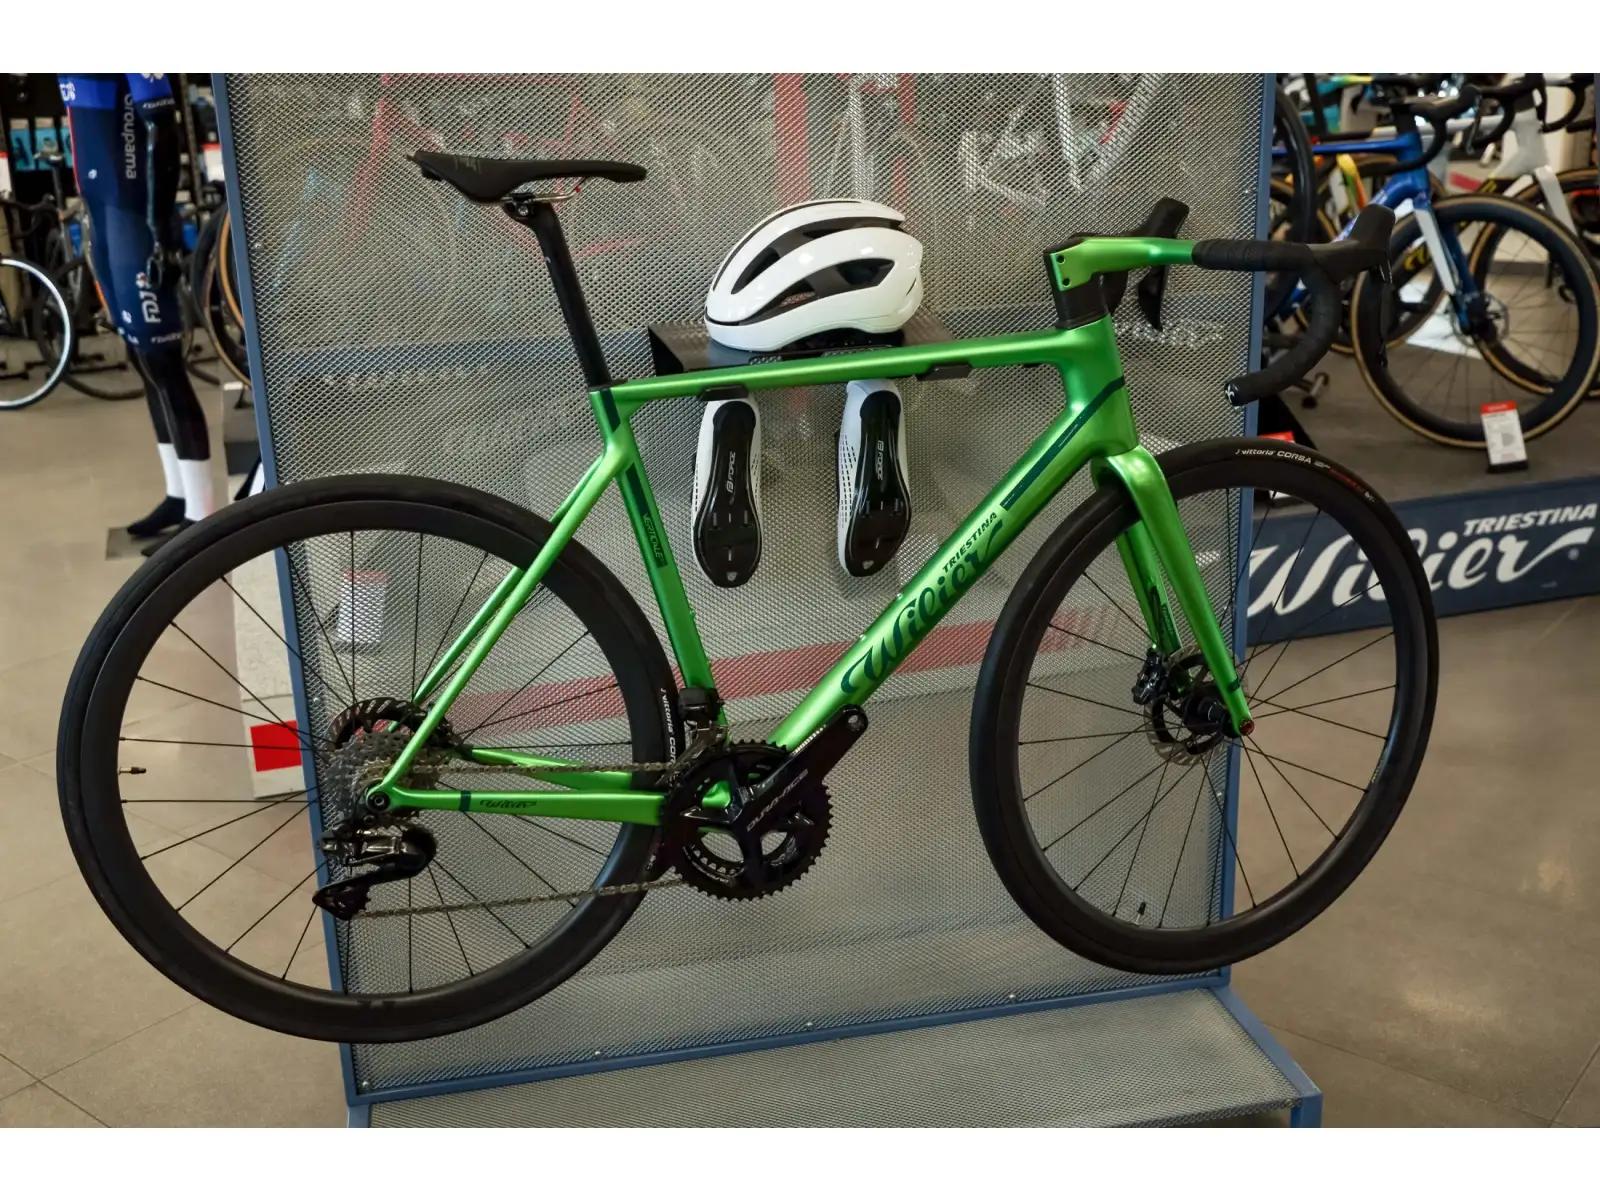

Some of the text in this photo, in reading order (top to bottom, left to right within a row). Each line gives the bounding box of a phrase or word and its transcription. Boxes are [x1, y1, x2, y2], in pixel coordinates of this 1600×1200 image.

[121, 94, 138, 180] Groupama
[139, 290, 162, 323] FDJ
[1277, 450, 1312, 464] CORSA
[942, 511, 998, 572] TRIESTINA
[1463, 503, 1598, 537] TRIESTINA
[841, 519, 1003, 693] Wilier
